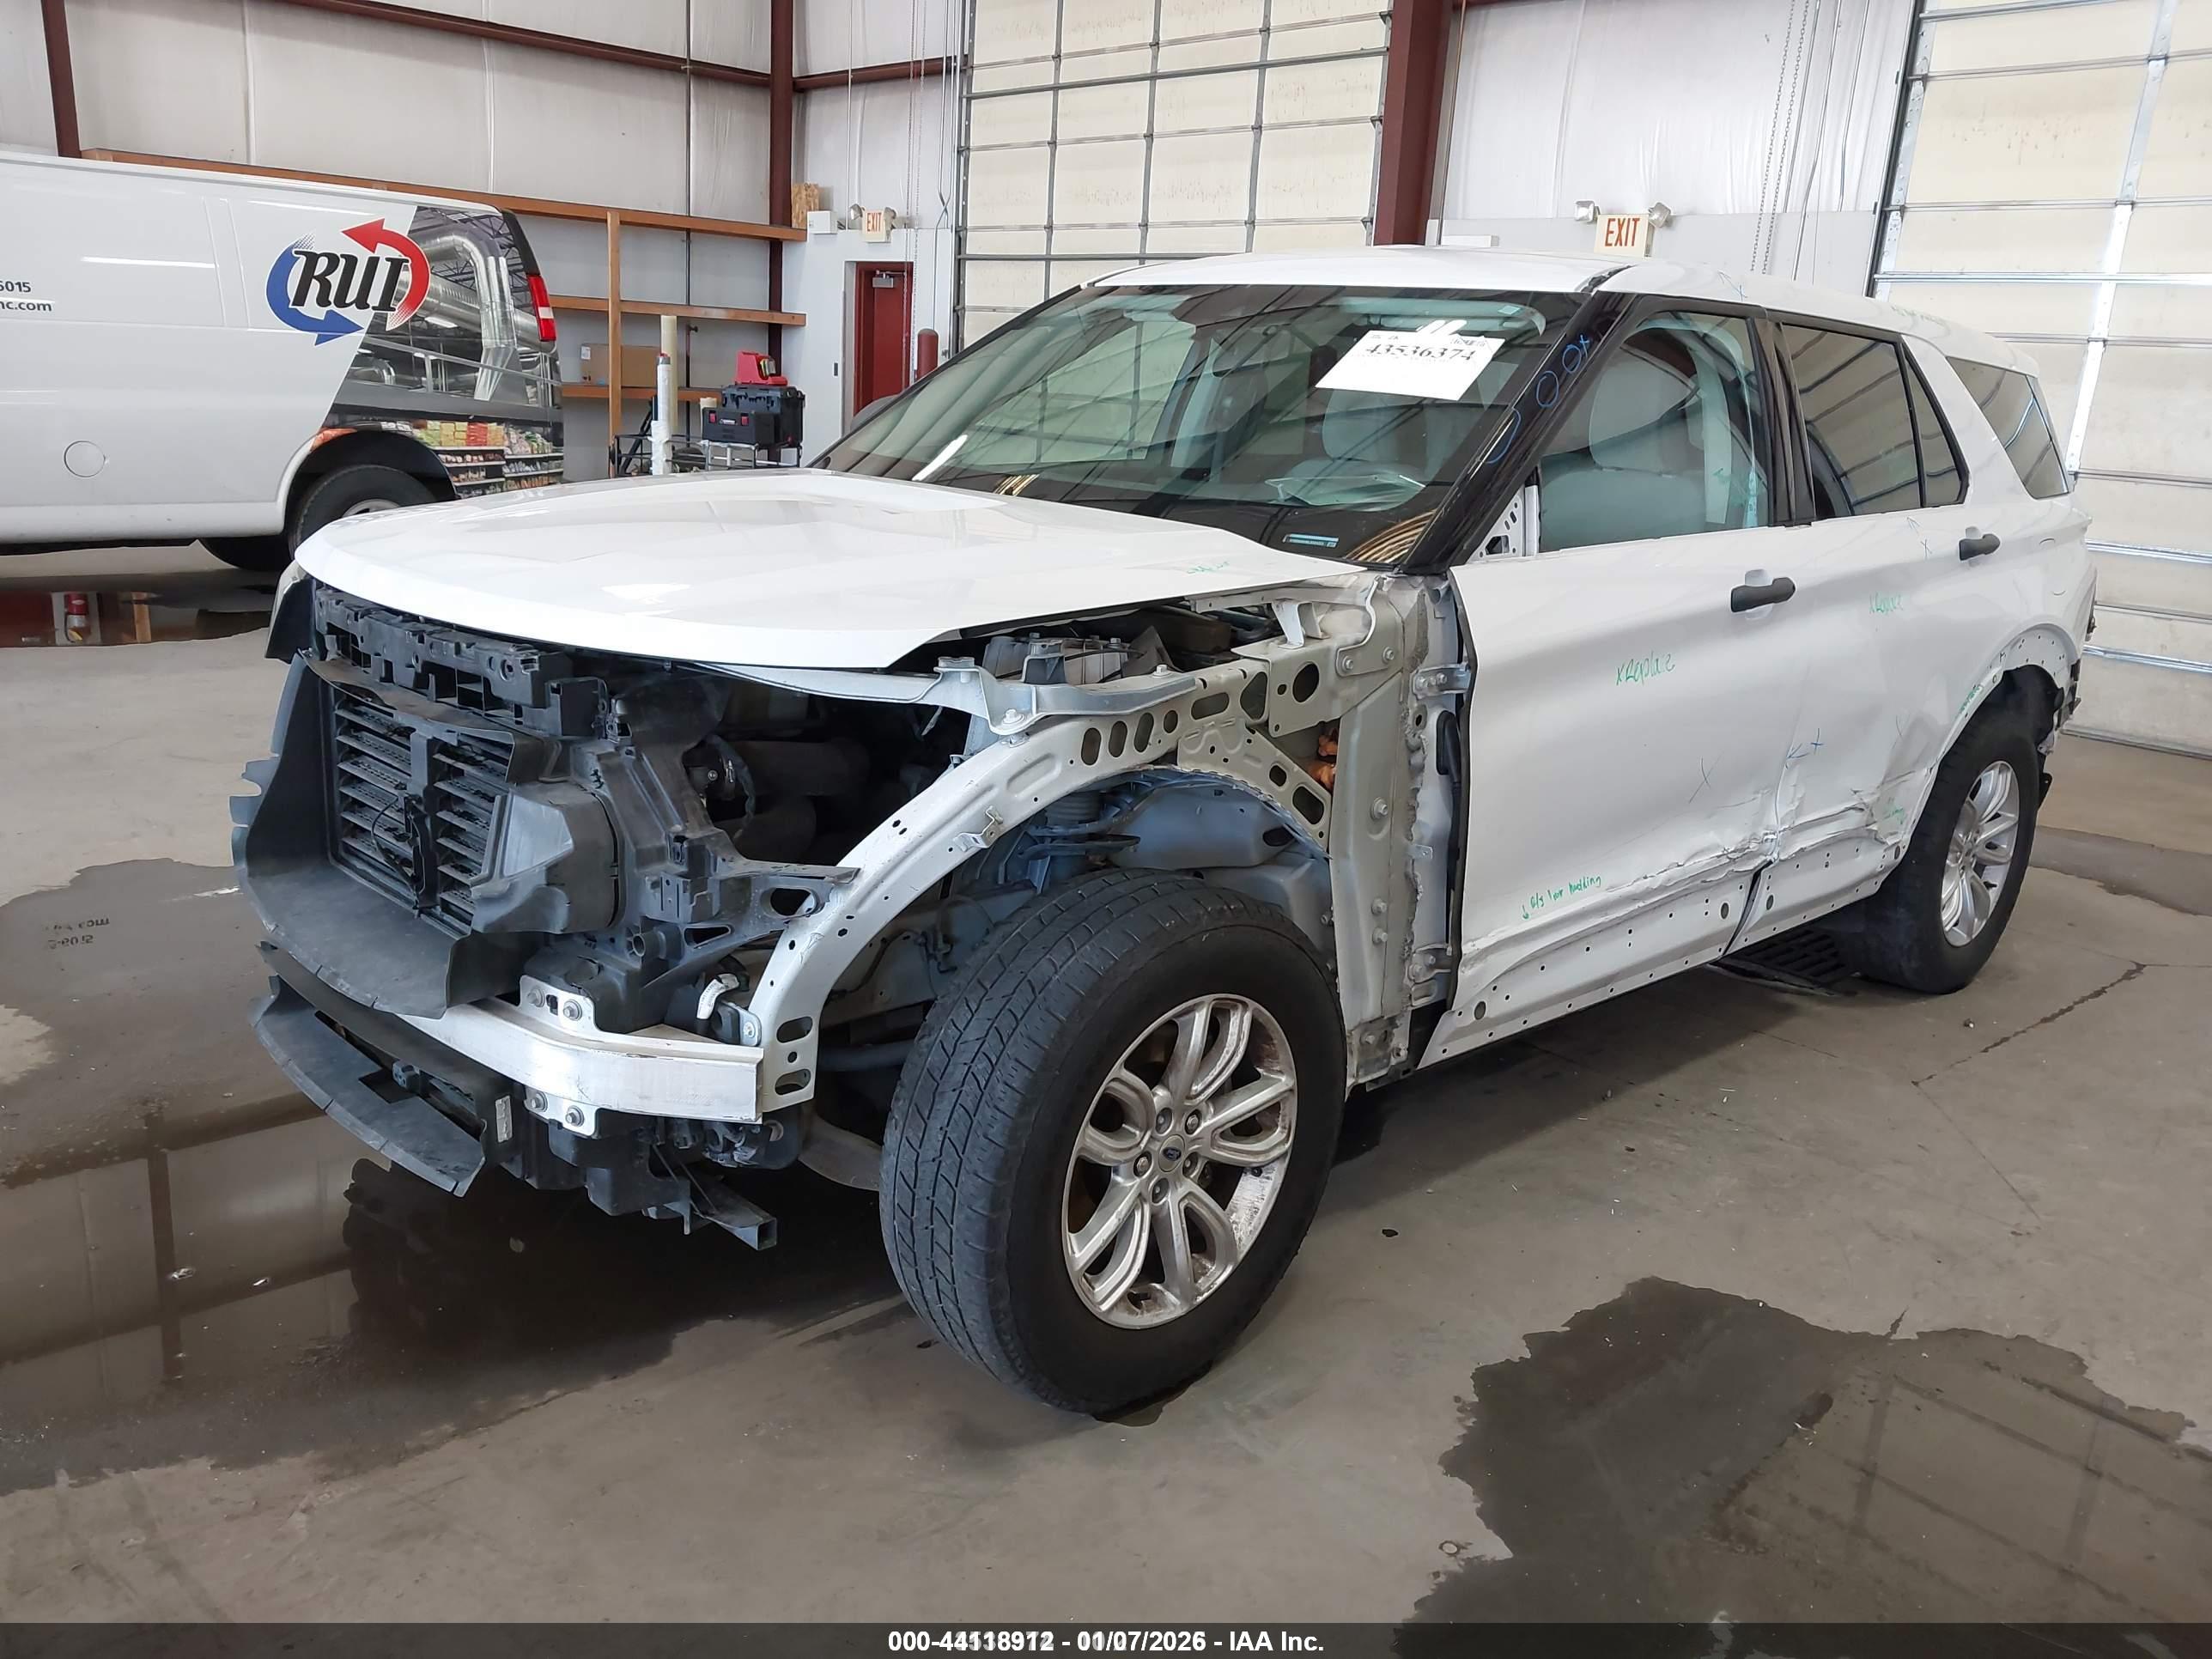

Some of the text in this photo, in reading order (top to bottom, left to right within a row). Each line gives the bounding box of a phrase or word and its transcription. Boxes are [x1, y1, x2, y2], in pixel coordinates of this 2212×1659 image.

[866, 212, 882, 232] EXIT
[1605, 217, 1640, 246] EXIT
[291, 250, 410, 312] RUI
